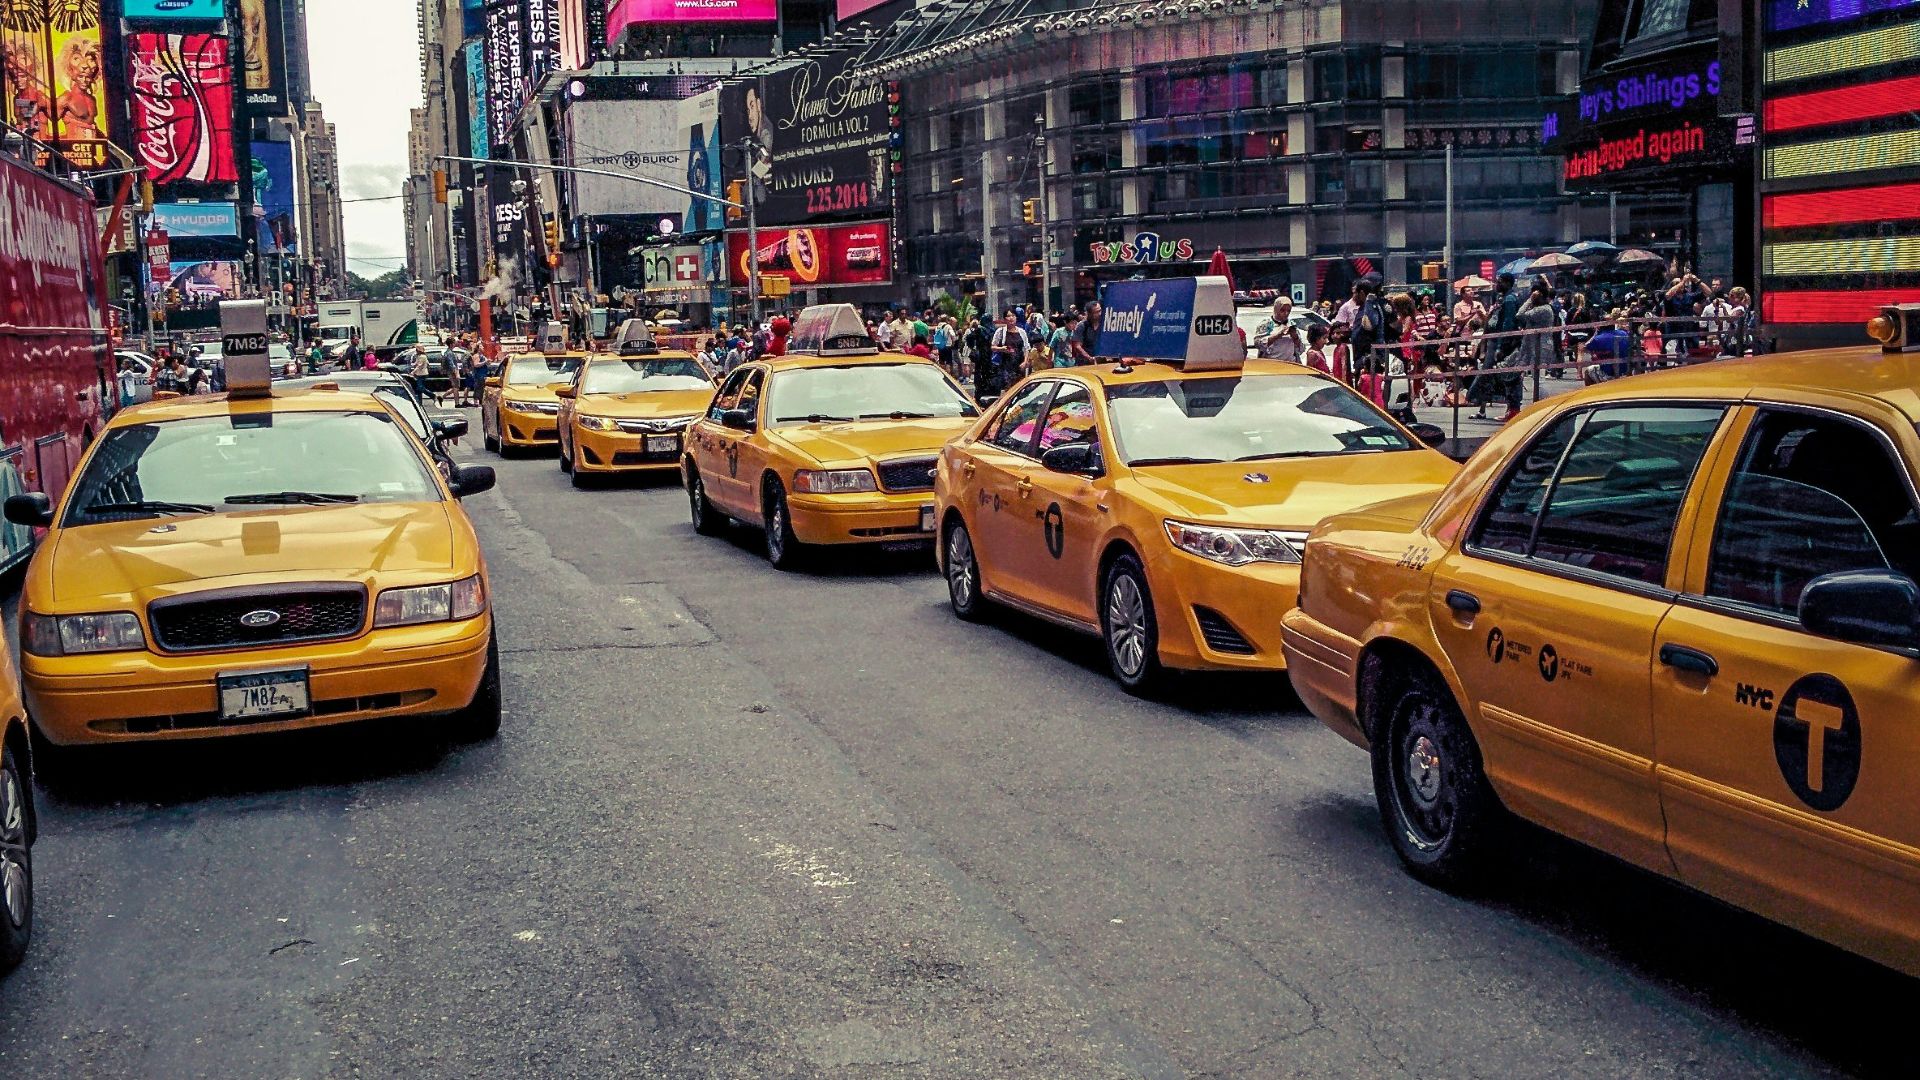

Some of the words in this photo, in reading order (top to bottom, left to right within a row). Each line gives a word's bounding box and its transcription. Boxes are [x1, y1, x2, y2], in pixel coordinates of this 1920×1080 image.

[1617, 72, 1700, 110] Siblings
[801, 121, 843, 143] FORMULA
[846, 117, 862, 134] VOL
[863, 115, 869, 131] 2
[1648, 121, 1704, 162] again
[73, 143, 92, 152] GET
[806, 182, 868, 213] 2.25.2014
[172, 215, 229, 225] HYUNDAI
[1103, 305, 1145, 338] Namely
[1197, 318, 1230, 333] 1H54
[226, 336, 267, 352] 7M82
[250, 613, 270, 624] Ford
[1736, 682, 1774, 711] NYC
[1795, 697, 1843, 792] T
